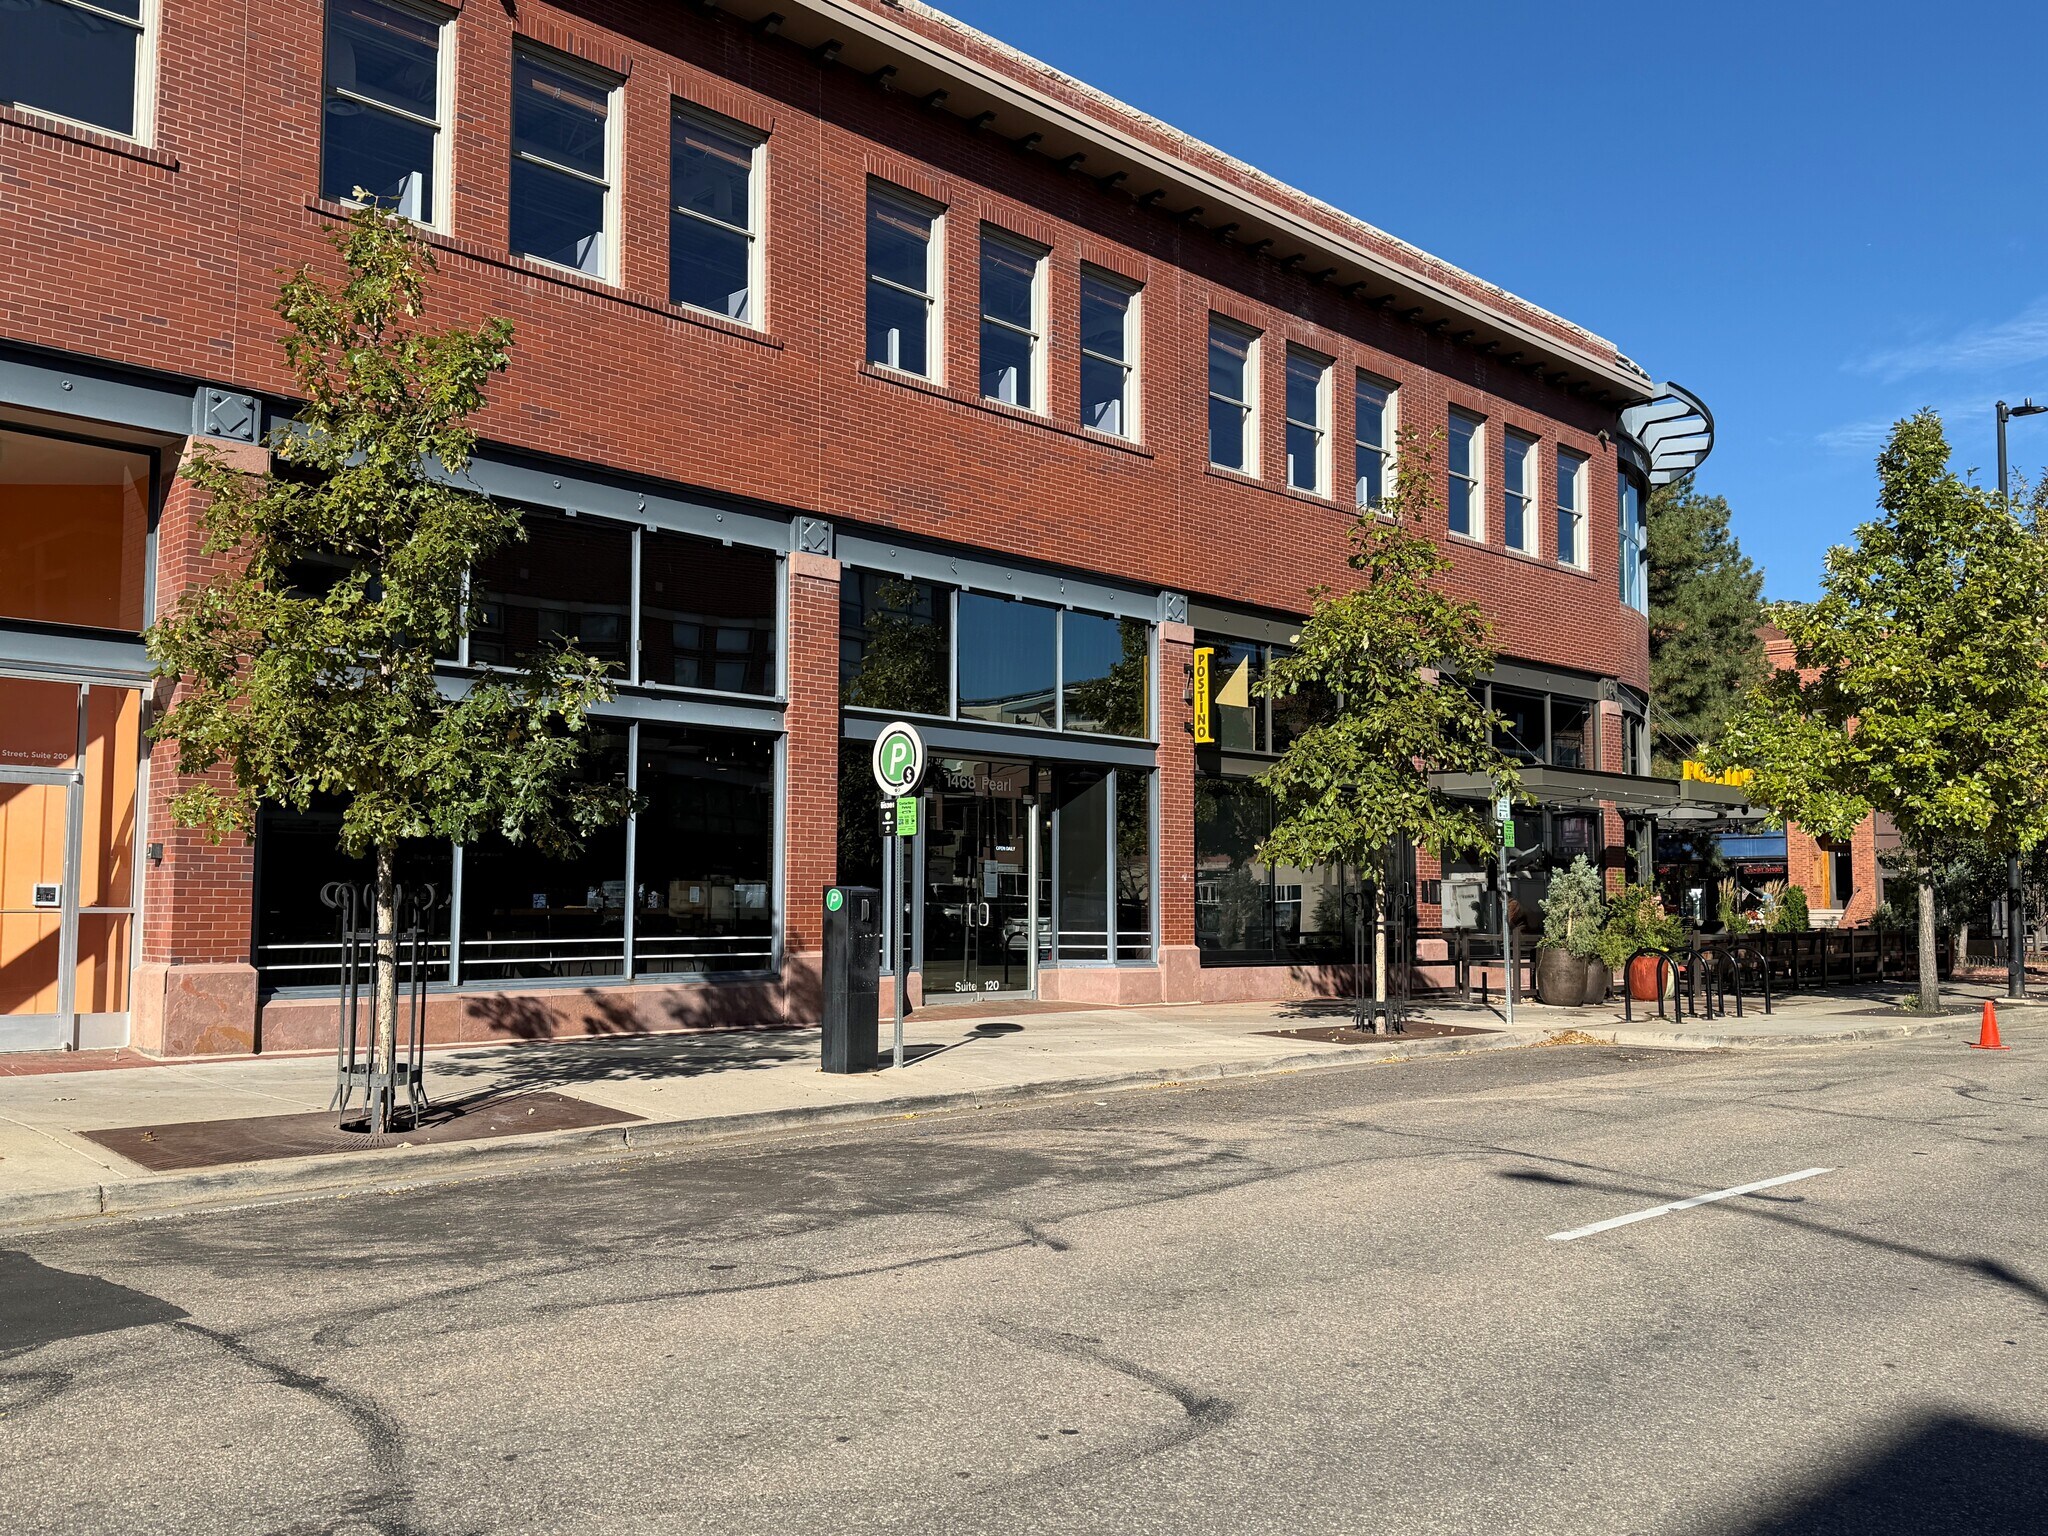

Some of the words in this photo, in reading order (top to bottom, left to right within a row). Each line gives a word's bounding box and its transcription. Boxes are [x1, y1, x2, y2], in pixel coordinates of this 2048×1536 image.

[1197, 654, 1206, 738] POSTINO
[2, 749, 29, 759] Street,
[31, 751, 51, 759] Suite
[53, 752, 68, 760] 200
[889, 742, 907, 776] P
[946, 774, 976, 789] 1468
[981, 776, 1011, 791] Pearl
[830, 892, 839, 908] P
[955, 979, 977, 992] Suite
[984, 980, 1000, 991] 120
